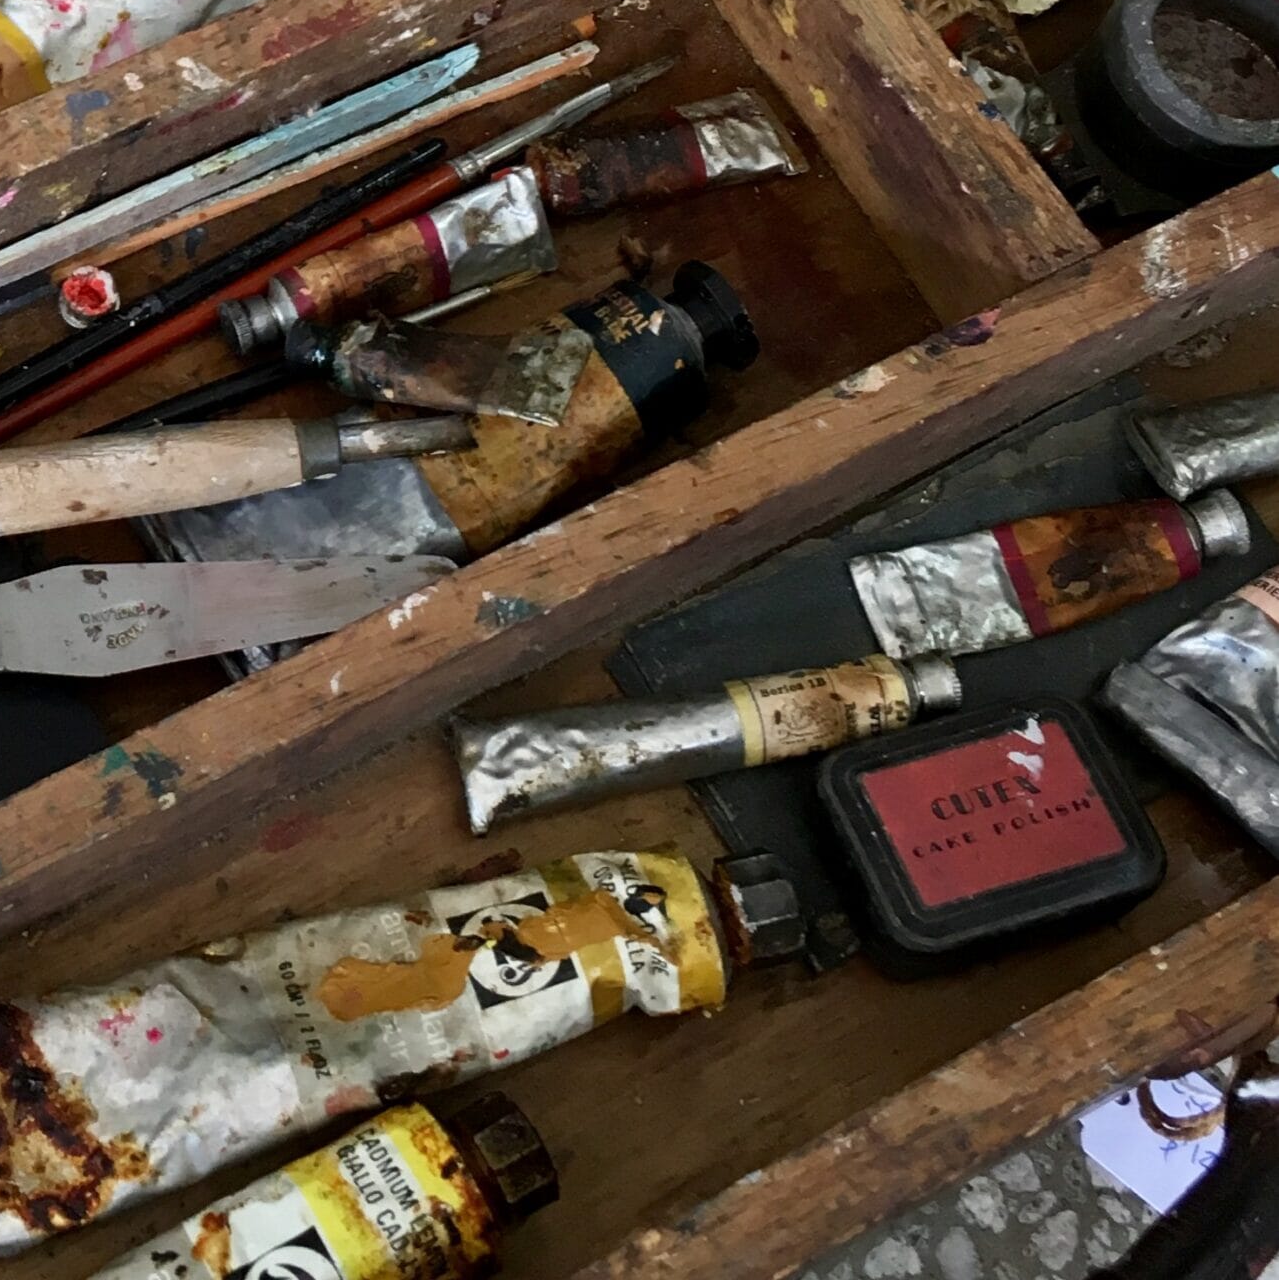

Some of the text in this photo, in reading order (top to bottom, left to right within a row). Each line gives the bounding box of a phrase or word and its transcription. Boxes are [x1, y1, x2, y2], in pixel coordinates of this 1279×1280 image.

[930, 775, 1041, 820] CUTEX
[912, 798, 1091, 858] CAKE POLISH
[277, 959, 296, 981] 60
[335, 1142, 385, 1206] GIALLO
[355, 1127, 420, 1211] CADMIUM
